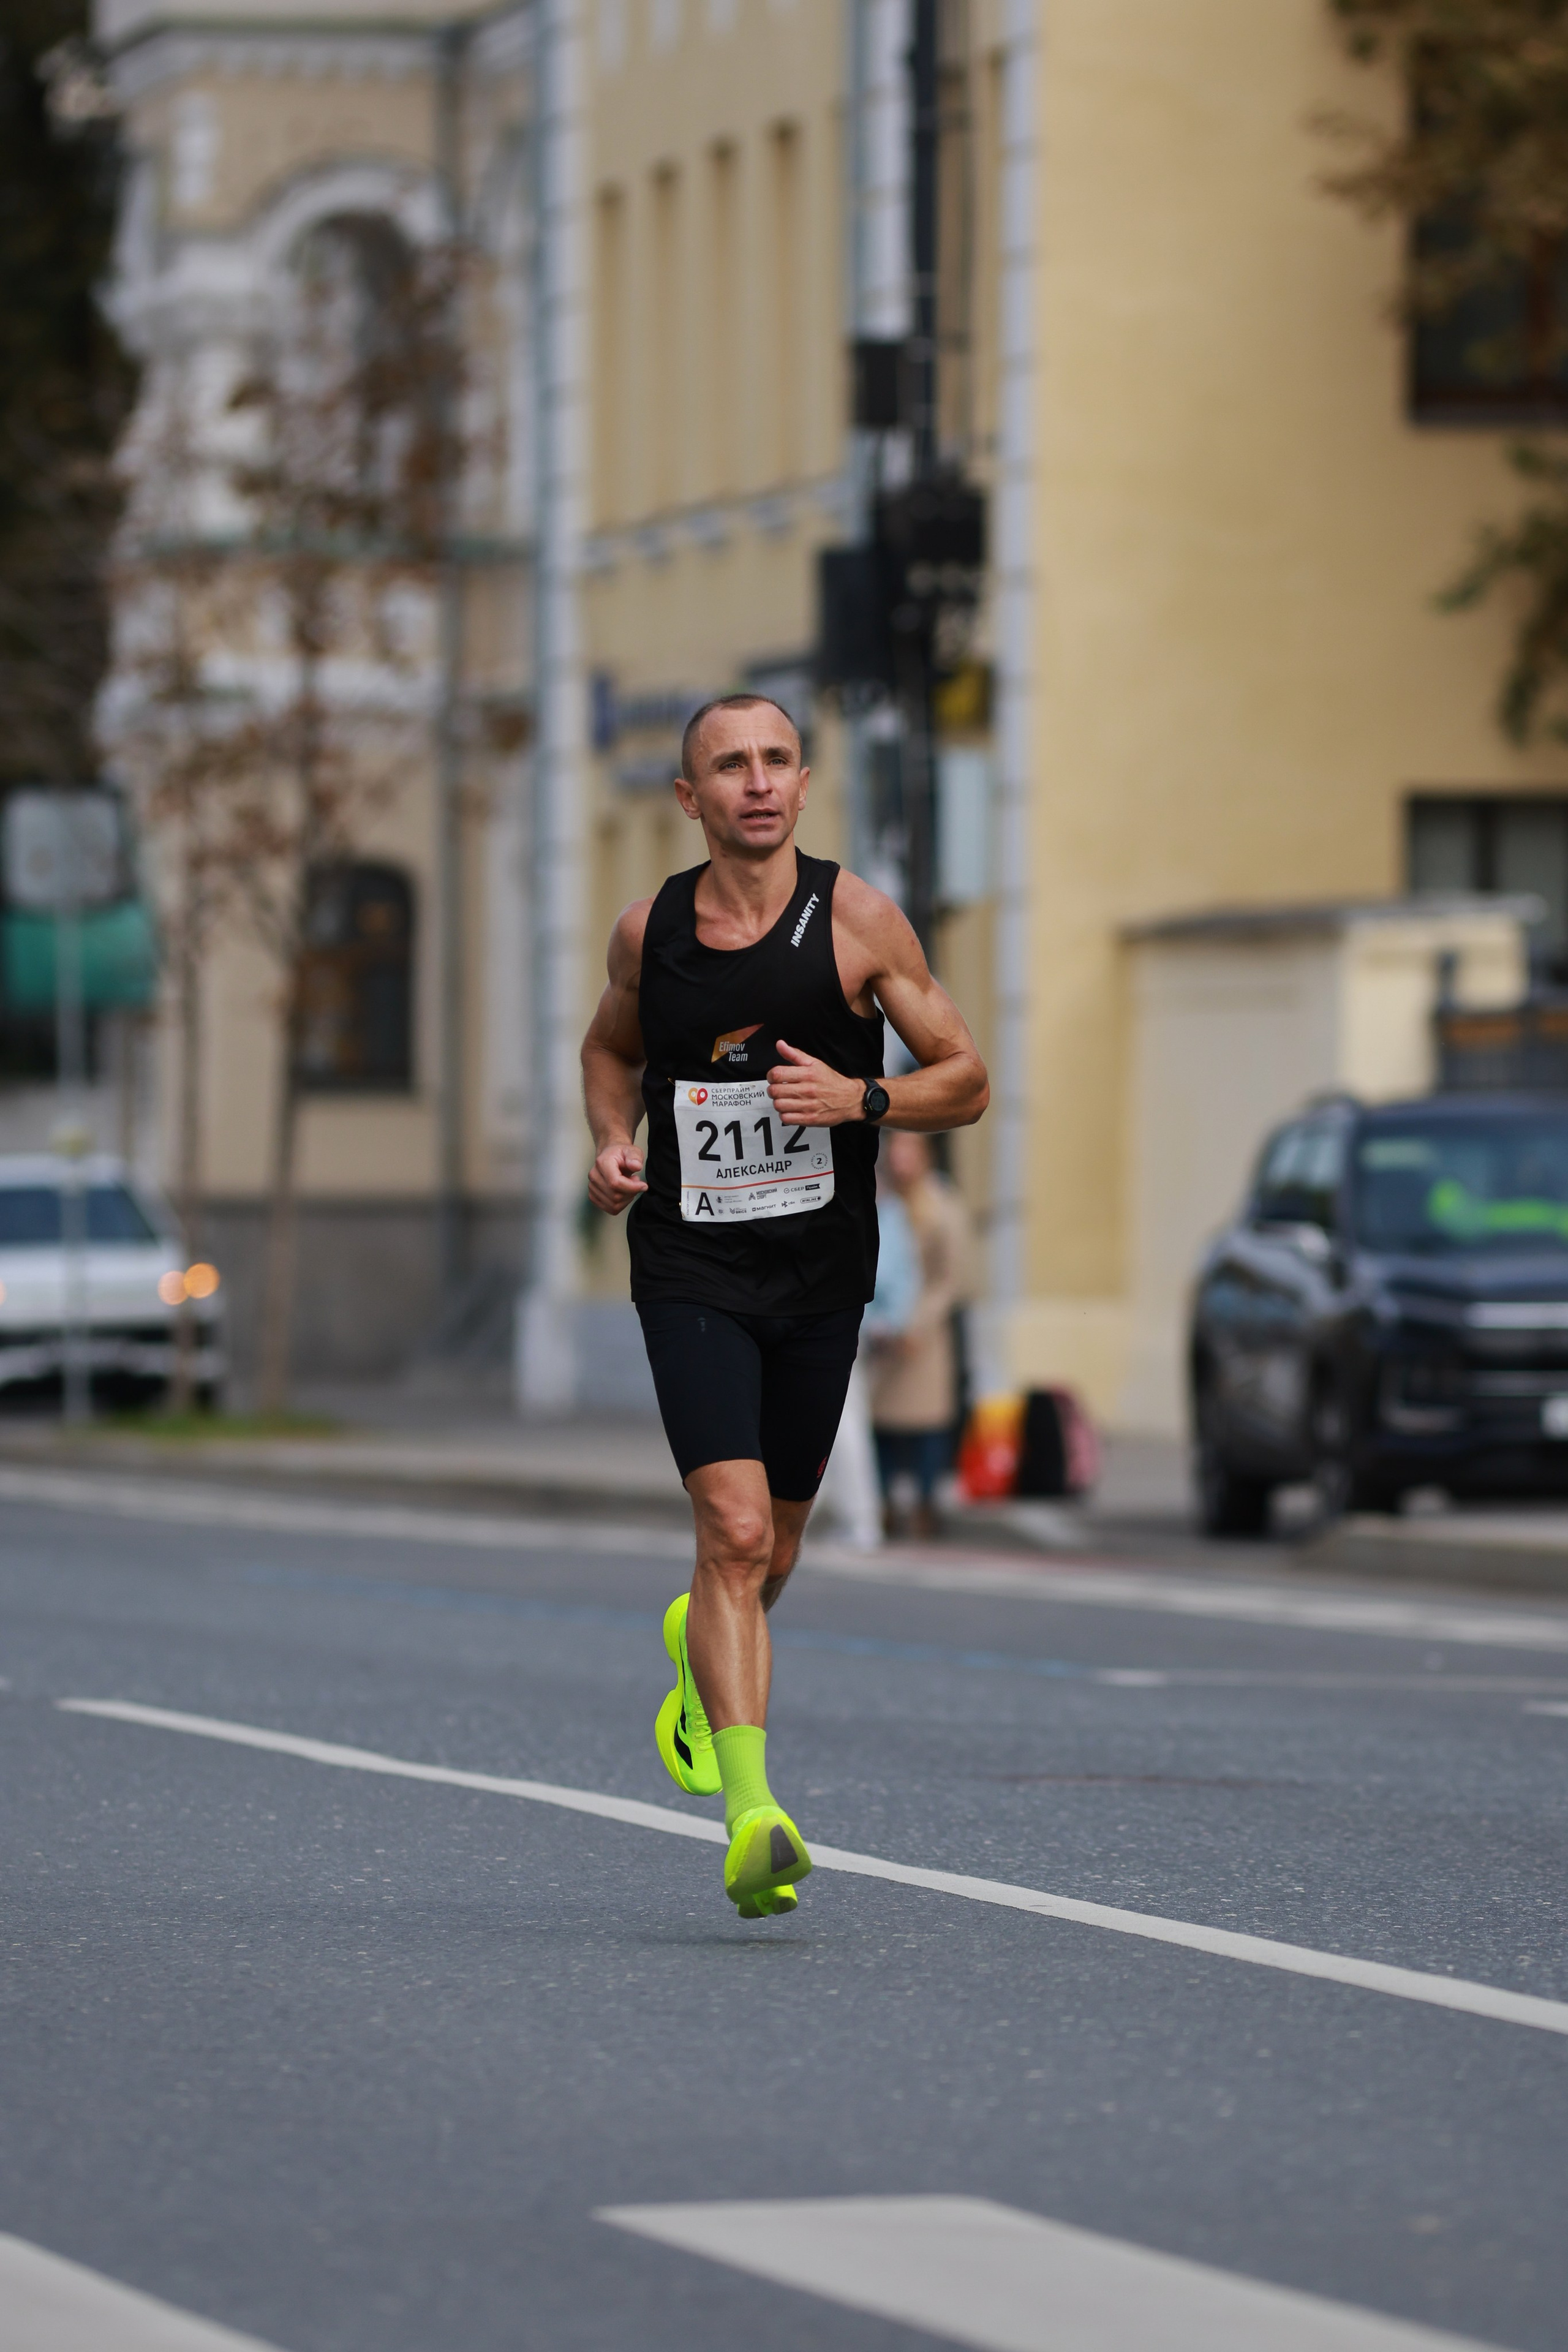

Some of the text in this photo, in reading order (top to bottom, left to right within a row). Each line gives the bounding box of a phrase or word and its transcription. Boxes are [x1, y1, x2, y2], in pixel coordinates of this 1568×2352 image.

[790, 892, 820, 948] INSANITY
[719, 1041, 745, 1052] Efimov
[728, 1052, 748, 1061] Team
[711, 1090, 765, 1100] МОСКОВСКИЙ
[695, 1117, 810, 1161] 2112
[716, 1160, 792, 1178] АЛЕКСАНДР
